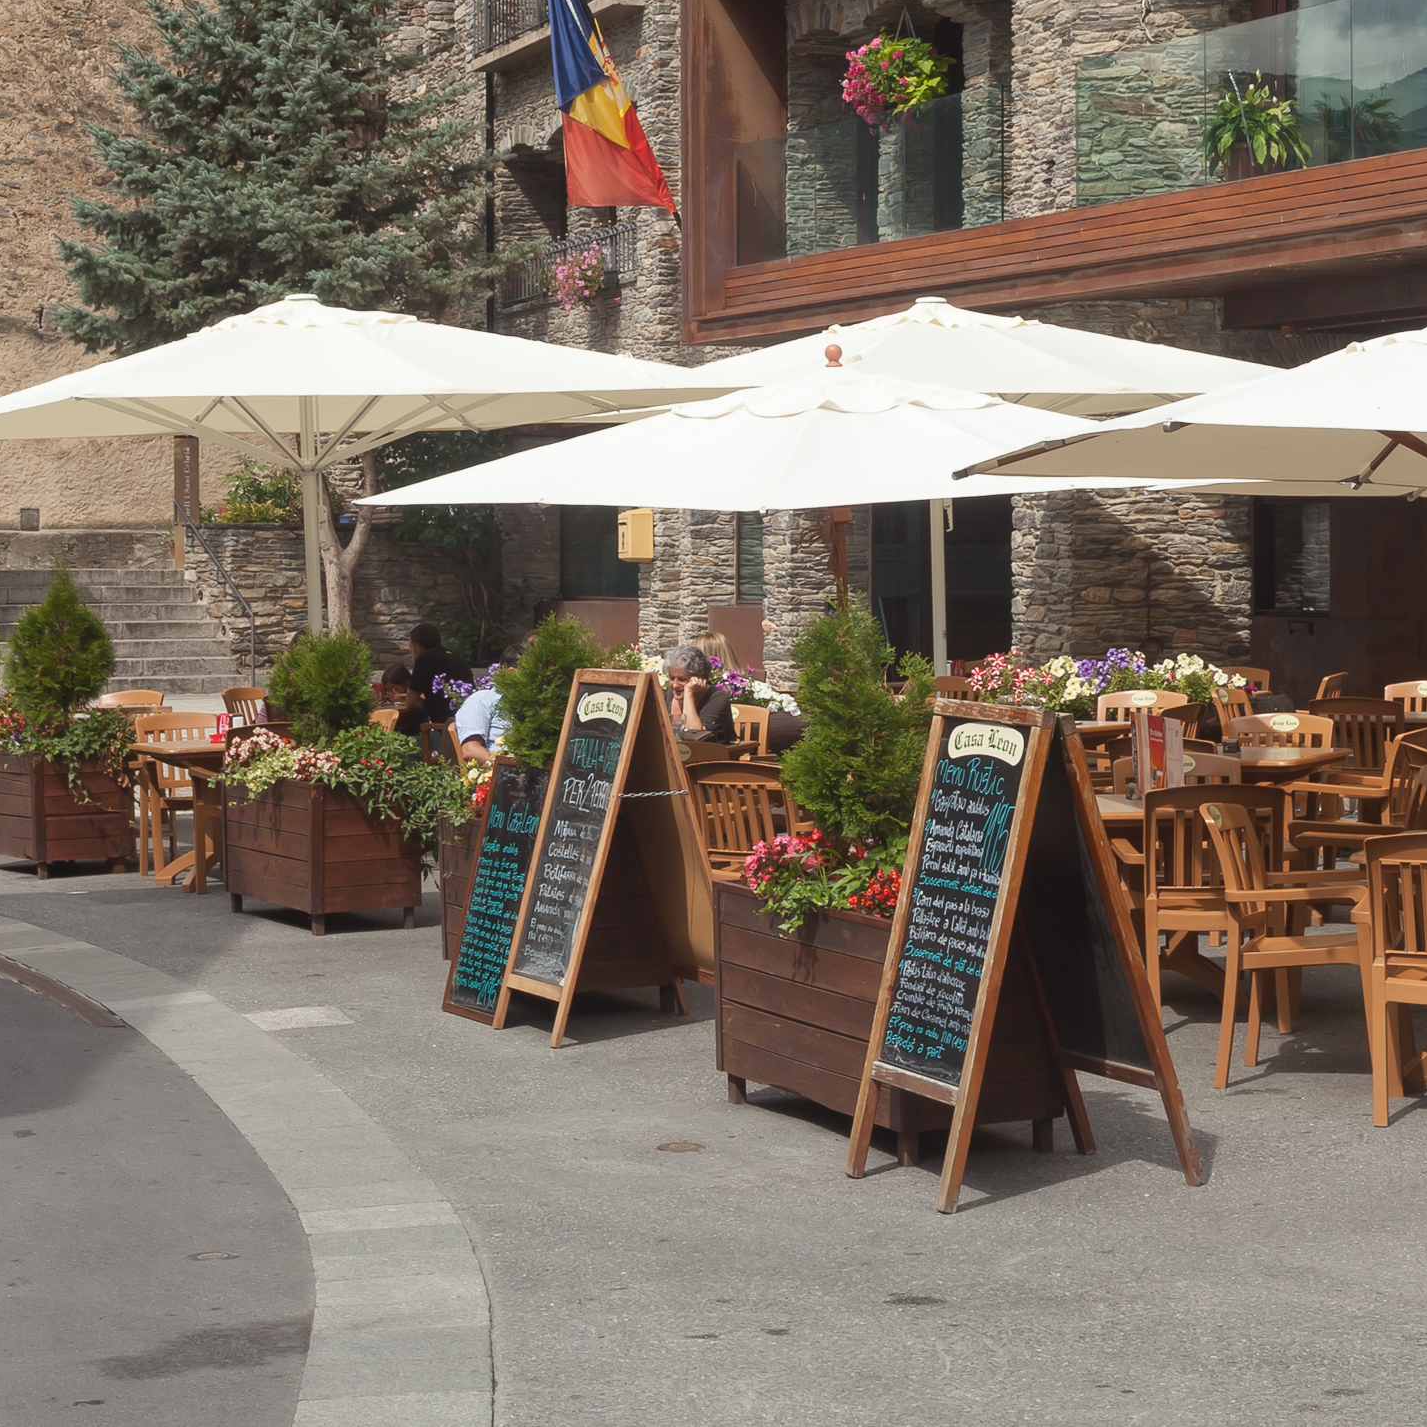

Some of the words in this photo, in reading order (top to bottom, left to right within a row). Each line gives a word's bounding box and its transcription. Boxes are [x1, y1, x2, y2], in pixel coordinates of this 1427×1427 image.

[583, 700, 604, 716] Casa
[606, 697, 625, 718] Leon
[954, 731, 984, 750] Casa
[988, 728, 1018, 757] Leon
